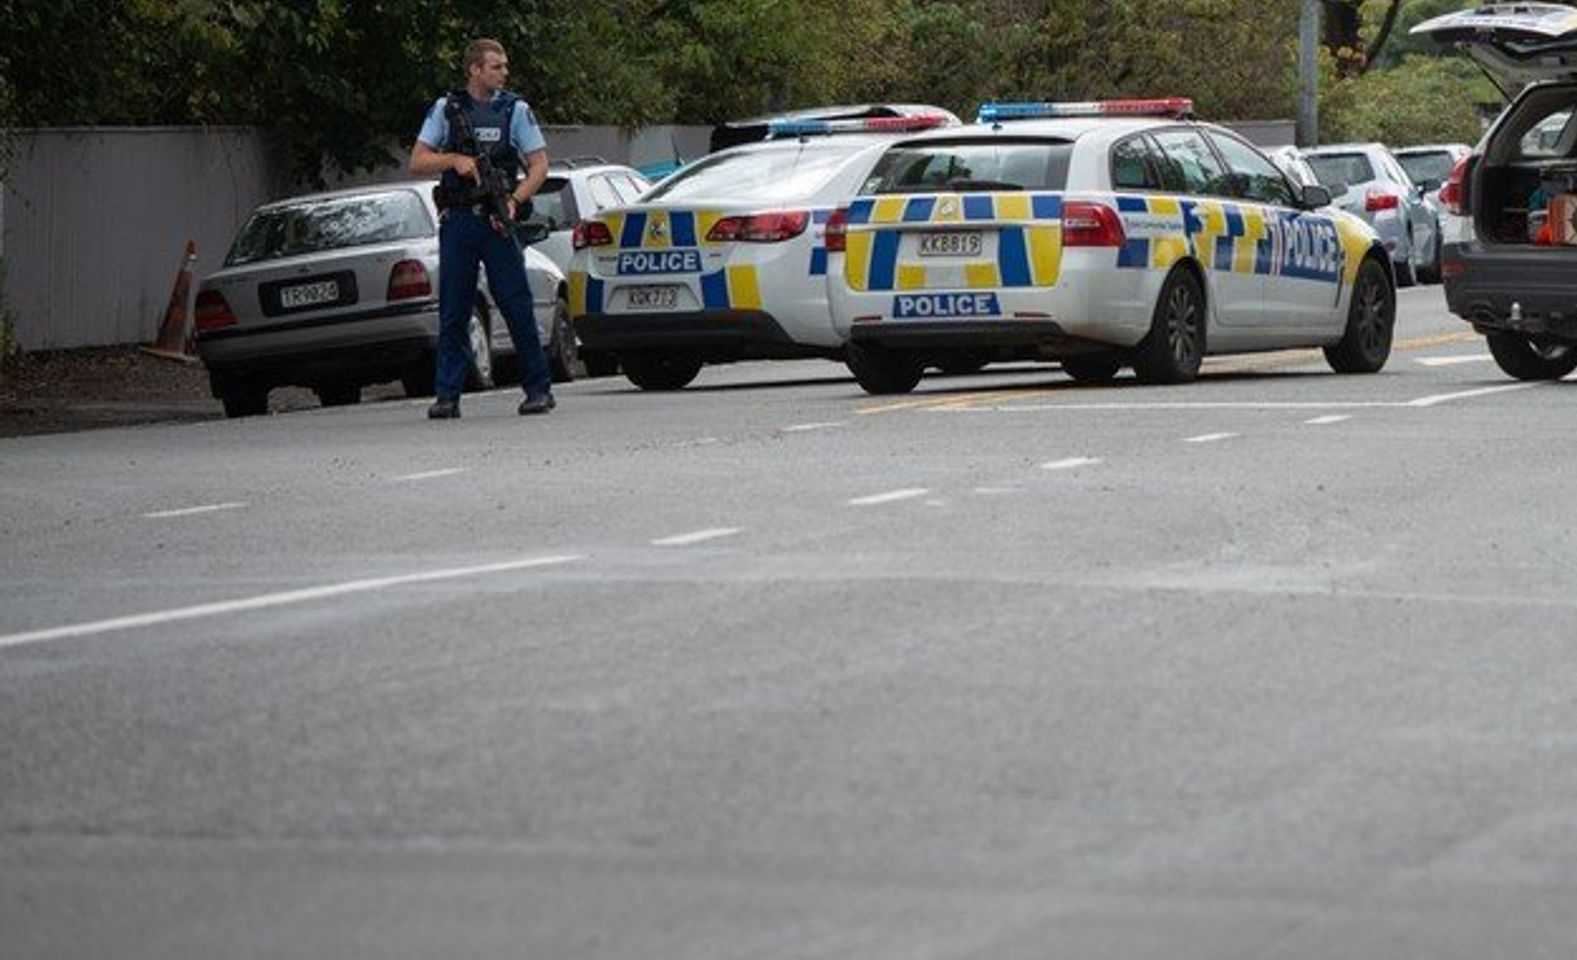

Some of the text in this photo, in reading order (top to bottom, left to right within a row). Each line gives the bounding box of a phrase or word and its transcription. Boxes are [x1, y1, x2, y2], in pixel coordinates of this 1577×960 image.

[1283, 218, 1337, 273] POLICE
[620, 252, 697, 273] POLICE
[898, 294, 992, 316] POLICE
